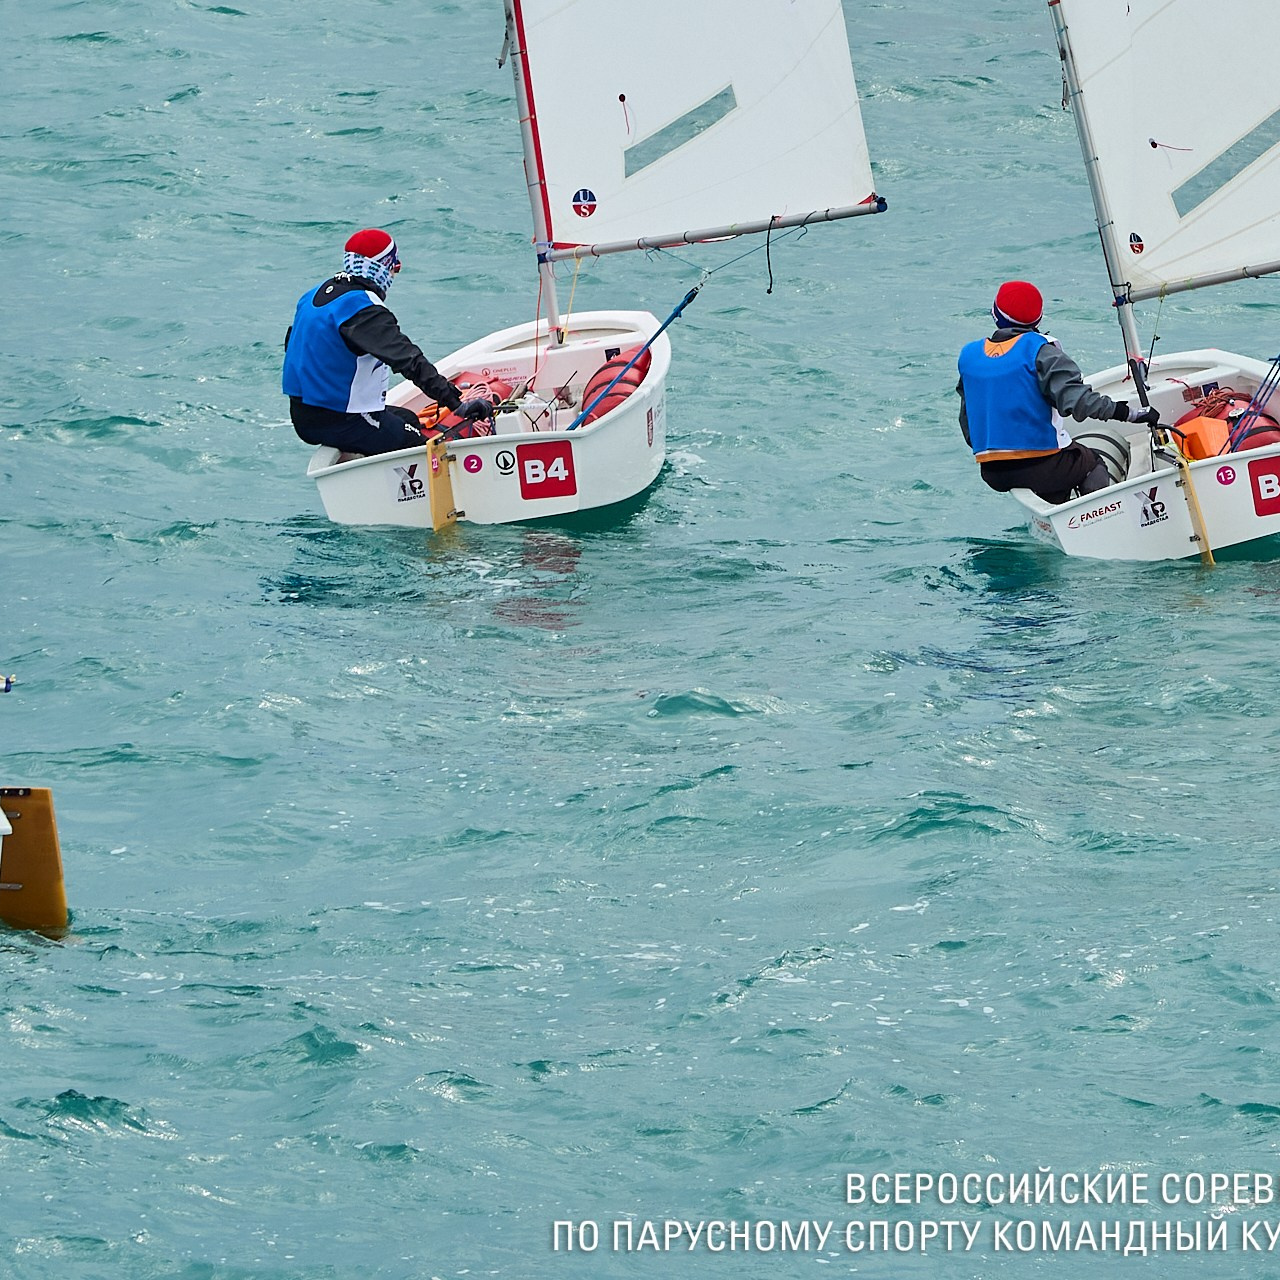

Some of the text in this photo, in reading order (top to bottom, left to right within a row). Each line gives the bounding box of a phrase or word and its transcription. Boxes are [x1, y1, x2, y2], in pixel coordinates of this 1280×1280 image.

[470, 459, 478, 469] 2
[524, 457, 568, 485] B4
[1218, 471, 1235, 482] 13
[1080, 501, 1122, 522] FAREAST
